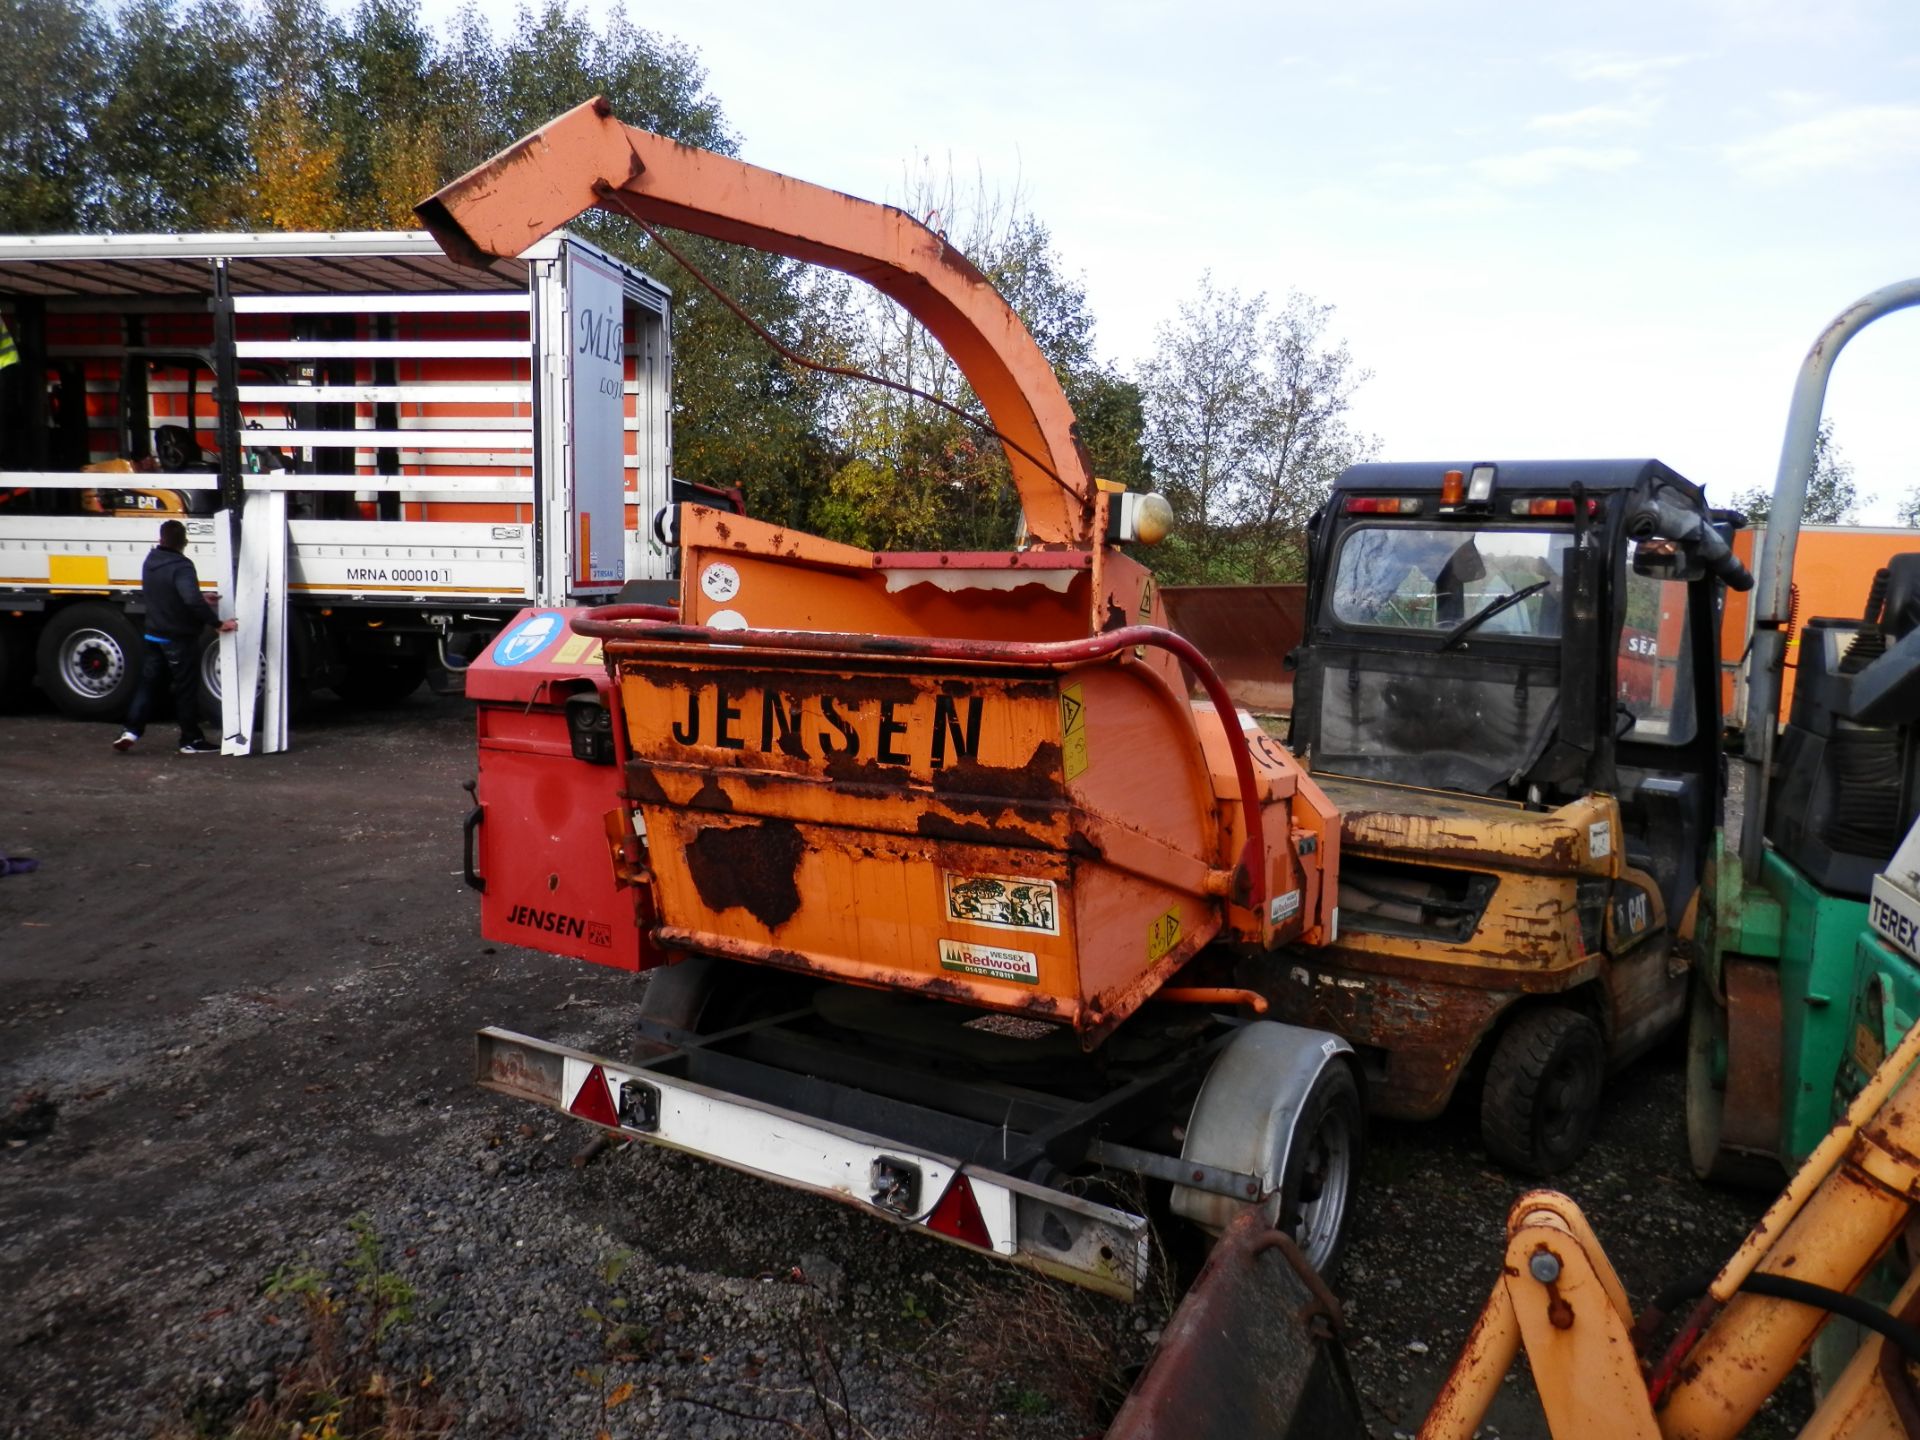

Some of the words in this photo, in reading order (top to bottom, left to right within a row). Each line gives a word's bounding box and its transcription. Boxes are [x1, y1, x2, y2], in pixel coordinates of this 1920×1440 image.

[301, 367, 314, 377] CAT
[137, 495, 158, 509] CAT
[346, 568, 388, 581] MRNA
[391, 569, 439, 582] 000010
[672, 682, 985, 769] JENSEN
[506, 904, 586, 939] JENSEN
[1628, 892, 1647, 934] CAT
[1873, 895, 1919, 954] TEREX
[962, 951, 1031, 973] Redwood
[989, 950, 1025, 963] WESSEX
